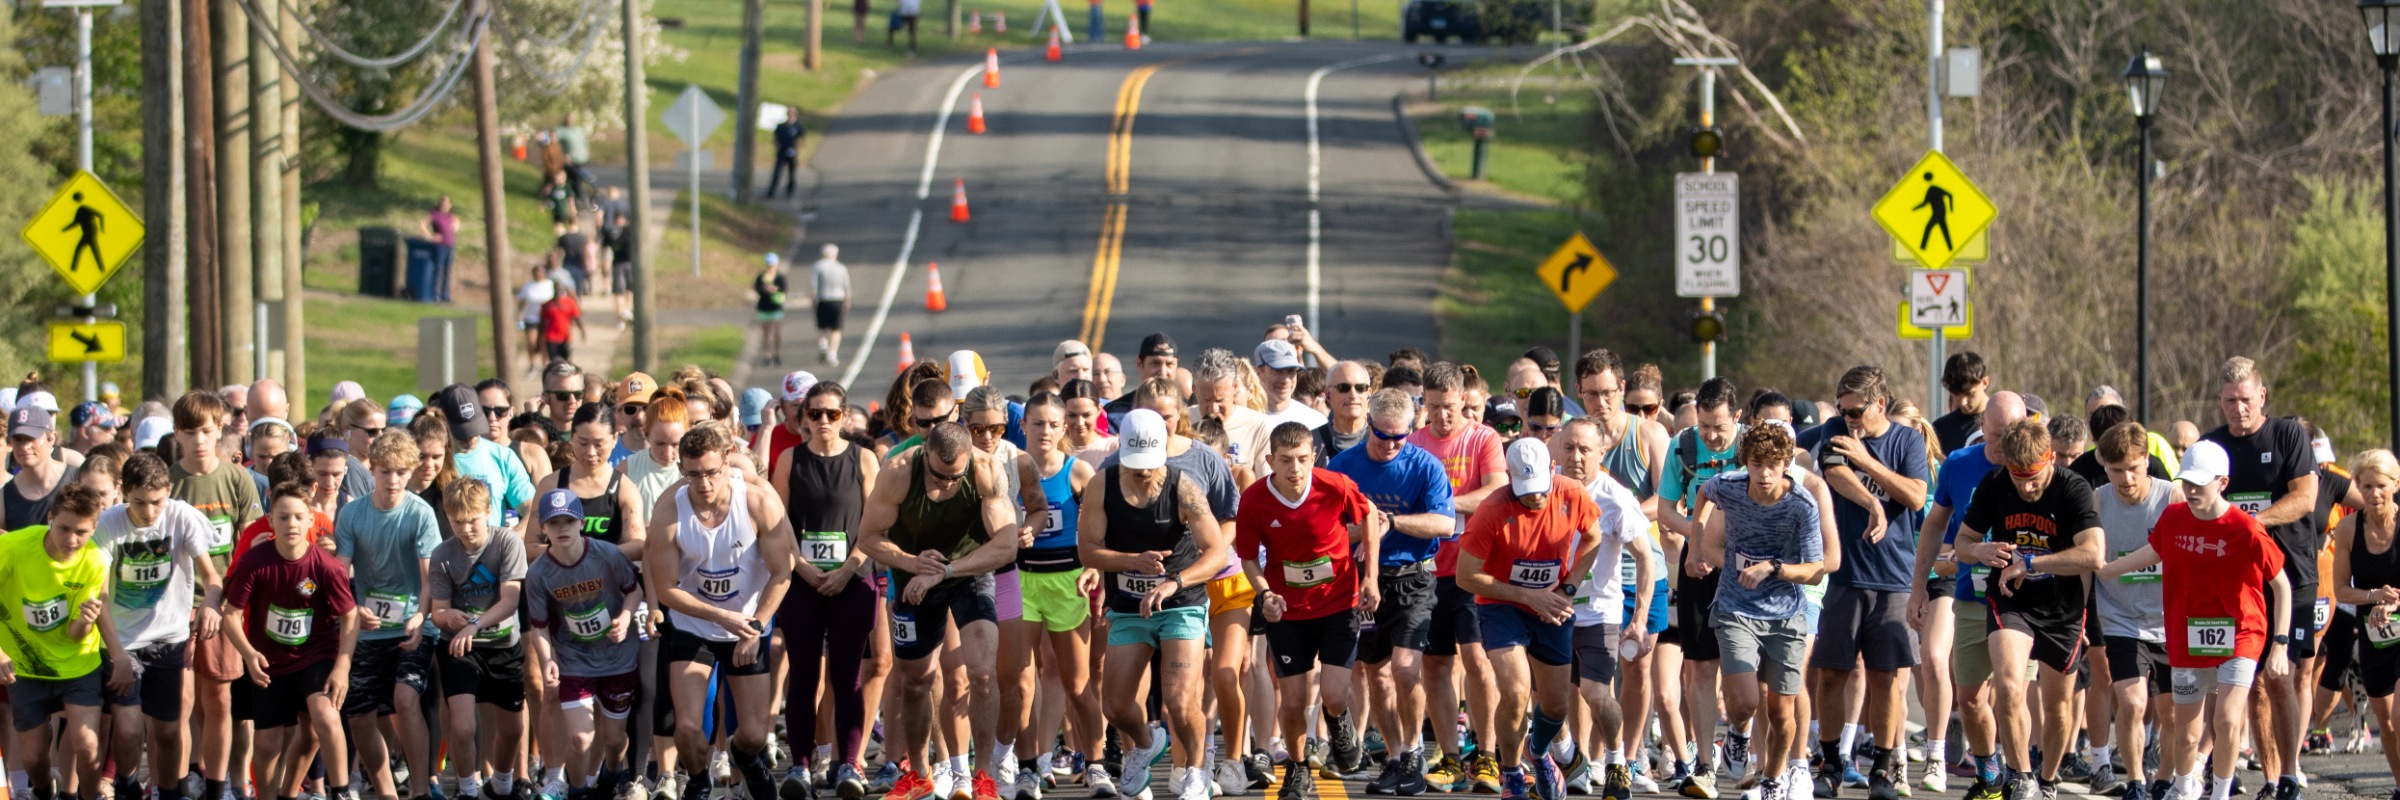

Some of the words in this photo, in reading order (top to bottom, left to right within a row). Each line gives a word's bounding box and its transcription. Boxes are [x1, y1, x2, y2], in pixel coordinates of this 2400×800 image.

[1685, 182, 1728, 193] SCHOOL
[1685, 201, 1731, 212] SPEED
[1689, 217, 1724, 229] LIMIT
[1689, 235, 1728, 263] 30
[1128, 436, 1159, 449] ciele
[2005, 512, 2058, 537] HARPOON
[811, 543, 836, 560] 121
[134, 565, 160, 581] 114
[1303, 569, 1314, 581] 3
[1519, 568, 1552, 582] 446
[554, 578, 605, 600] GRANBY
[703, 578, 731, 594] 470
[1126, 578, 1157, 593] 485
[32, 605, 60, 625] 138
[375, 601, 392, 619] 72
[277, 618, 301, 636] 179
[574, 619, 602, 634] 115
[2197, 628, 2227, 646] 162
